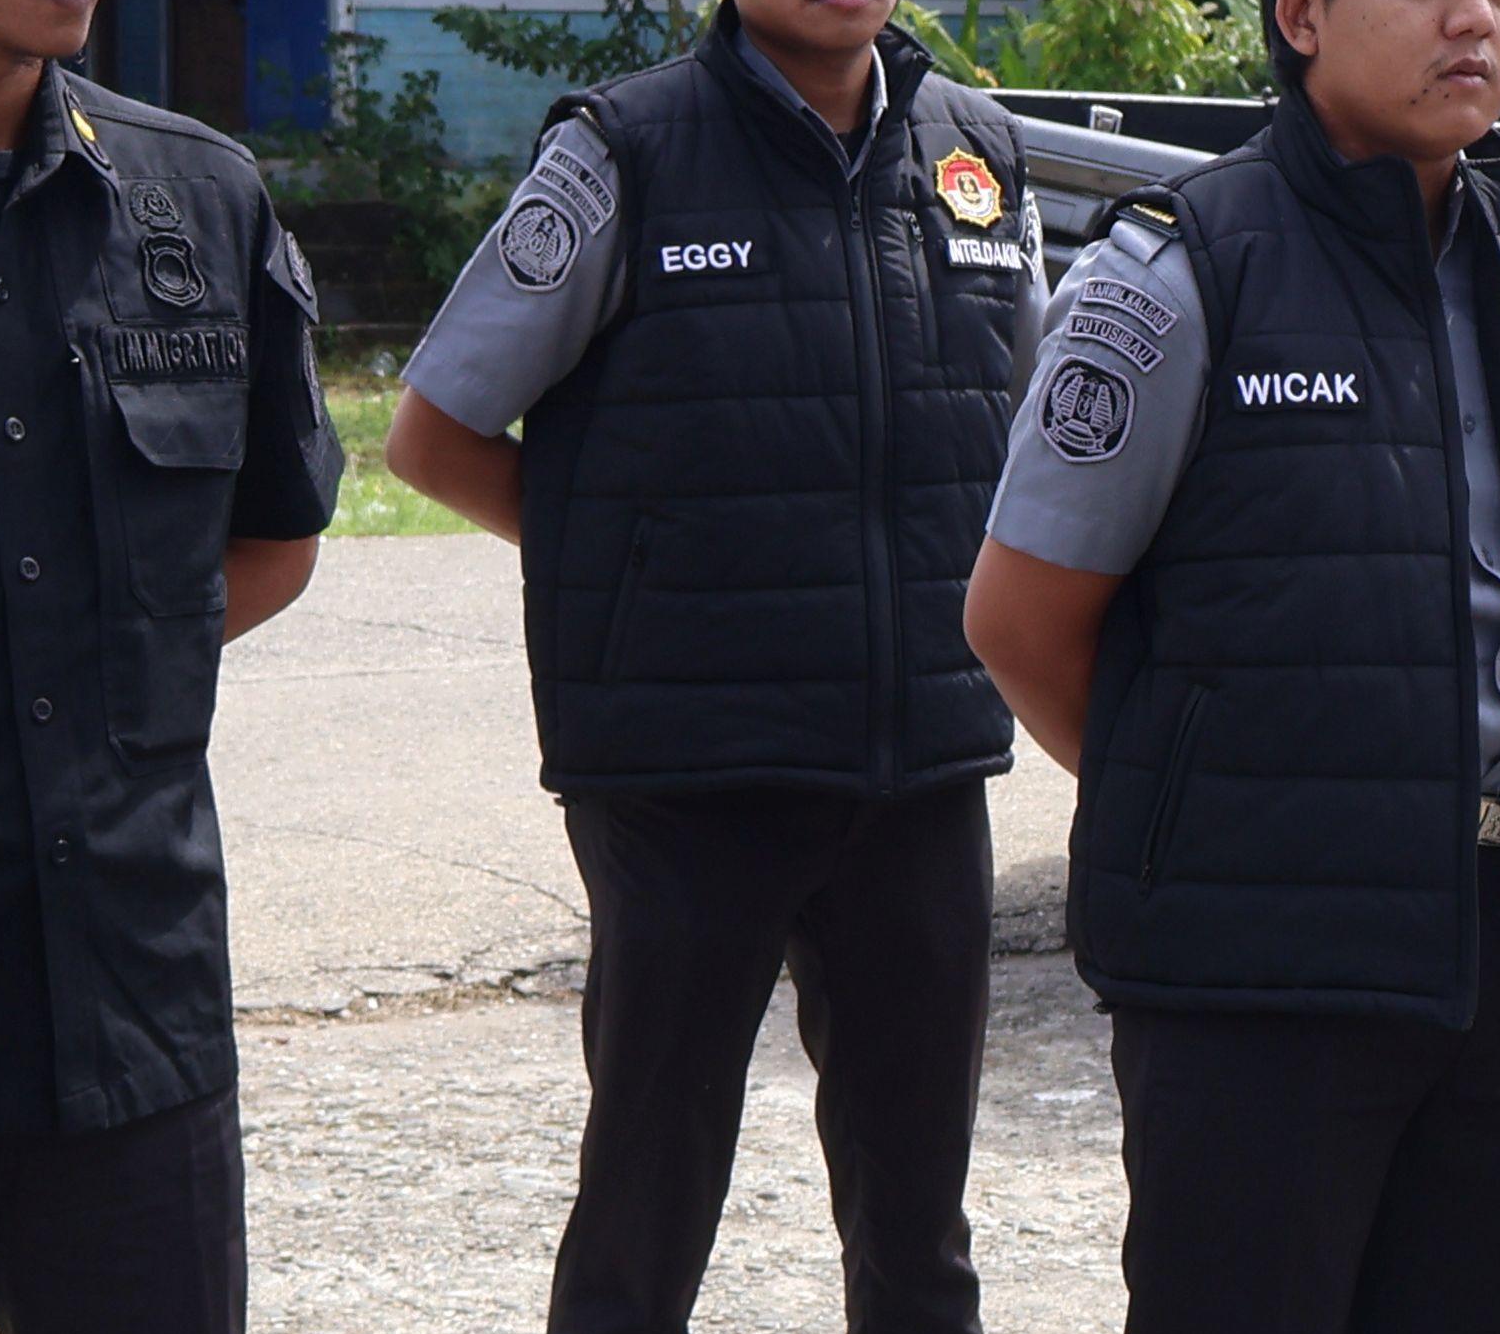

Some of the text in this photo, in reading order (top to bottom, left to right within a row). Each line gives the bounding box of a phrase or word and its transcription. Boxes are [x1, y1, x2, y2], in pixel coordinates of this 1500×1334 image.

[661, 240, 752, 273] EGGY
[1074, 317, 1154, 364] PUTUSIBAU
[1237, 372, 1359, 405] WICAK
